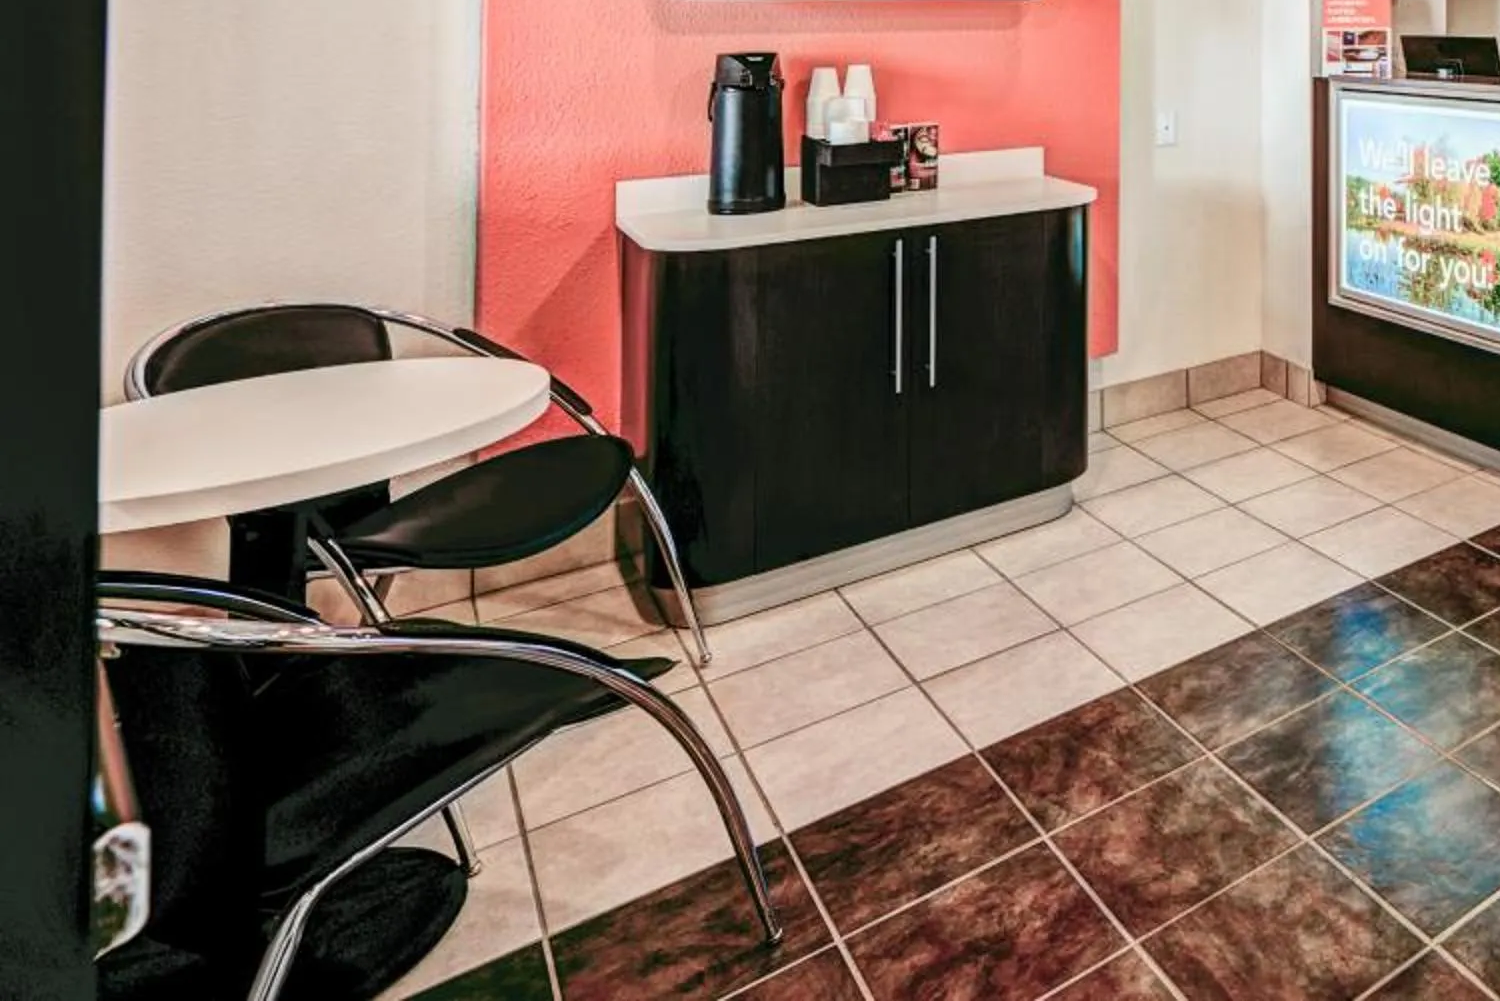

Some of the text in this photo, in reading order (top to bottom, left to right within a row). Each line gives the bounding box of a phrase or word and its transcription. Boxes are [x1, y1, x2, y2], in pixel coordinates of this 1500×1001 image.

[1424, 145, 1491, 187] leave
[1360, 186, 1462, 236] the light
[1360, 238, 1387, 265] on
[1397, 236, 1431, 274] for
